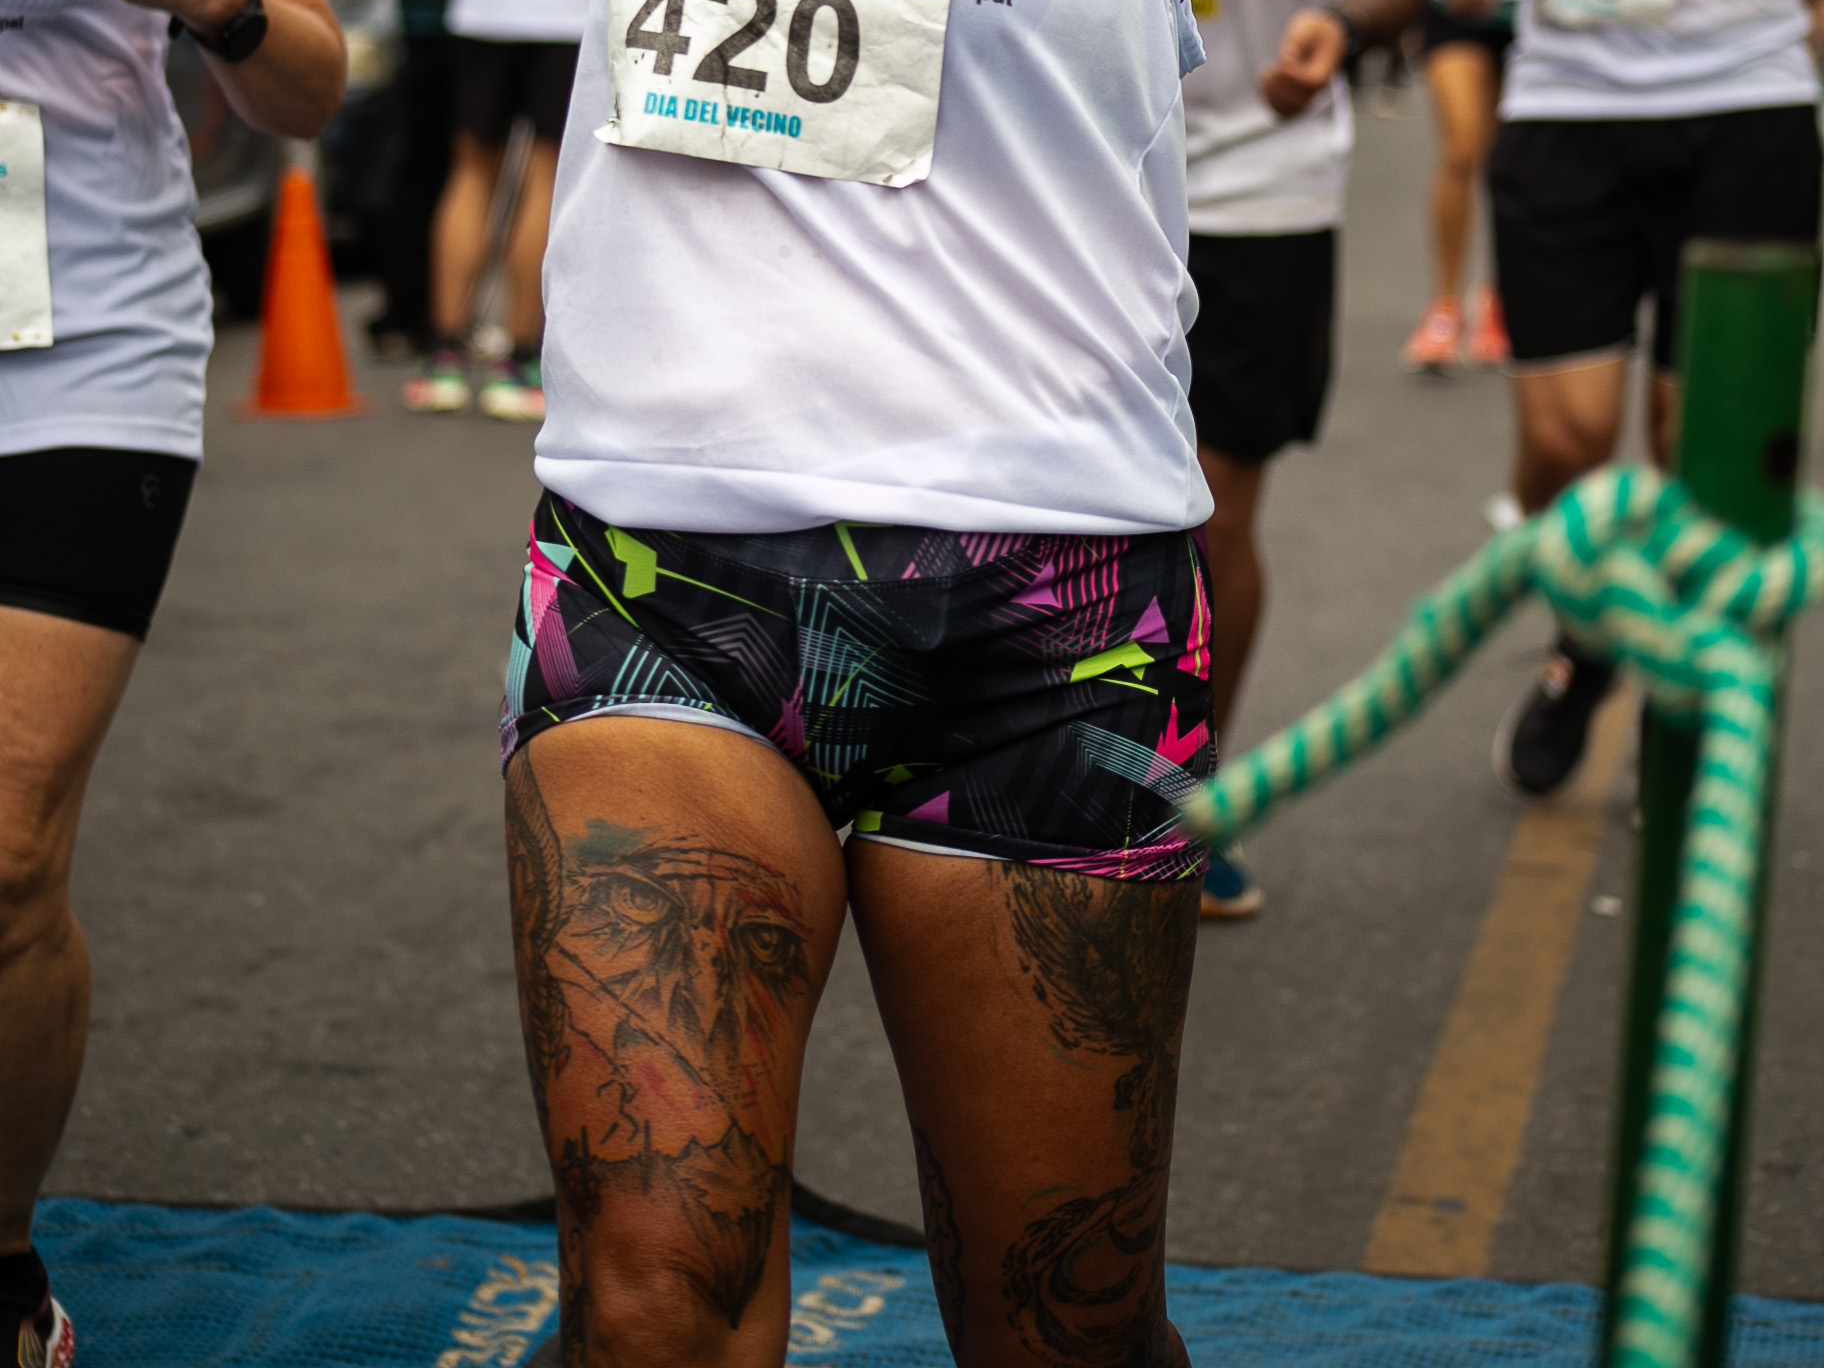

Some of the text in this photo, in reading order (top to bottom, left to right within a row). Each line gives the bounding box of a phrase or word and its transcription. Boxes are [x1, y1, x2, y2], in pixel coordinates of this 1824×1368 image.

[644, 91, 802, 139] DIA DEL VECINO
